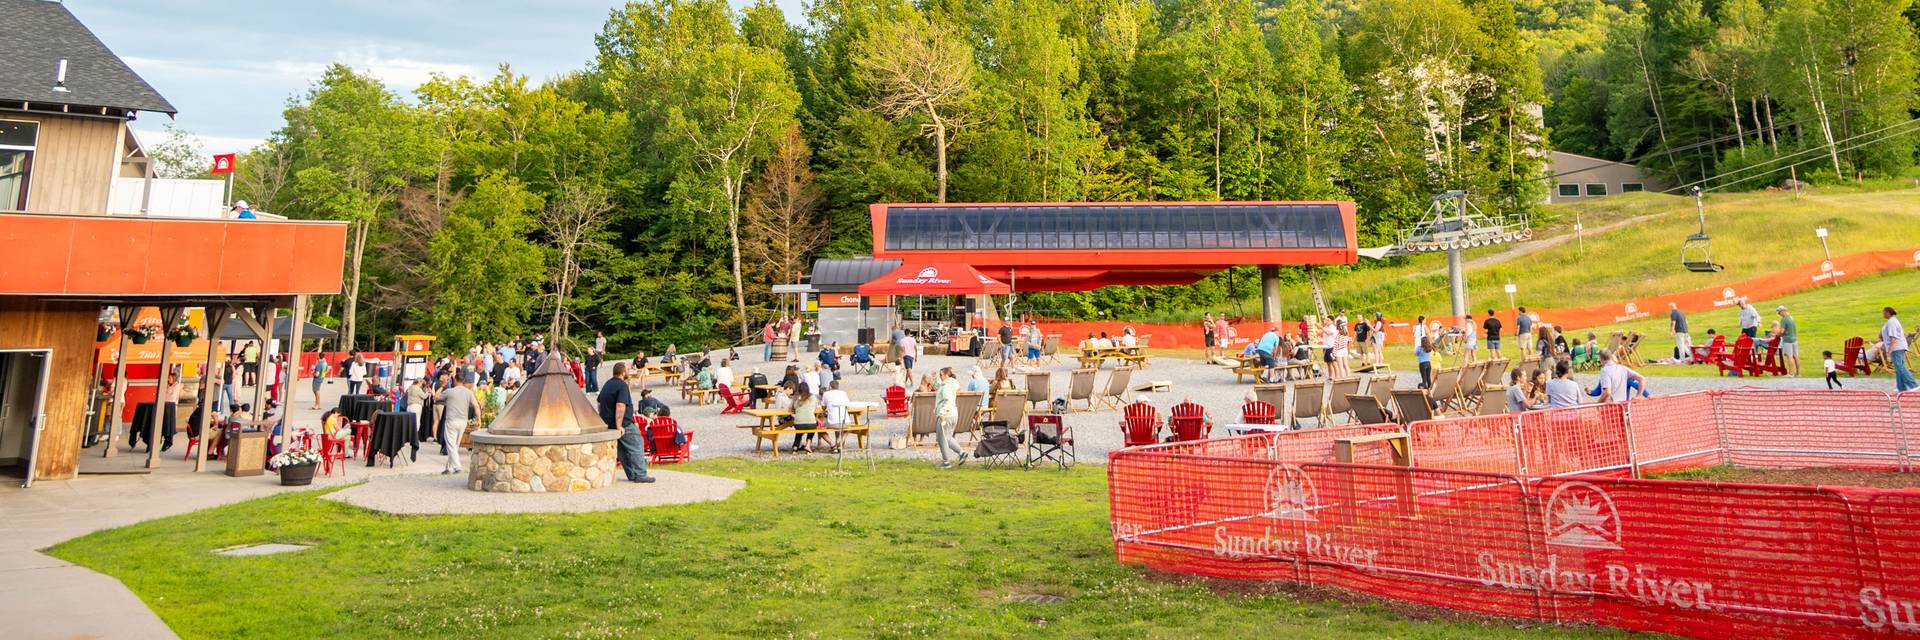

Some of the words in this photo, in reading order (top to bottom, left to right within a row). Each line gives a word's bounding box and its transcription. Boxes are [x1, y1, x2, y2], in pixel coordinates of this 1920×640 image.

[896, 276, 927, 285] Sunday
[841, 295, 859, 304] Chon
[1213, 525, 1299, 560] Sunday
[1306, 532, 1378, 568] River
[1477, 550, 1598, 601] Sunday
[1604, 563, 1712, 610] River
